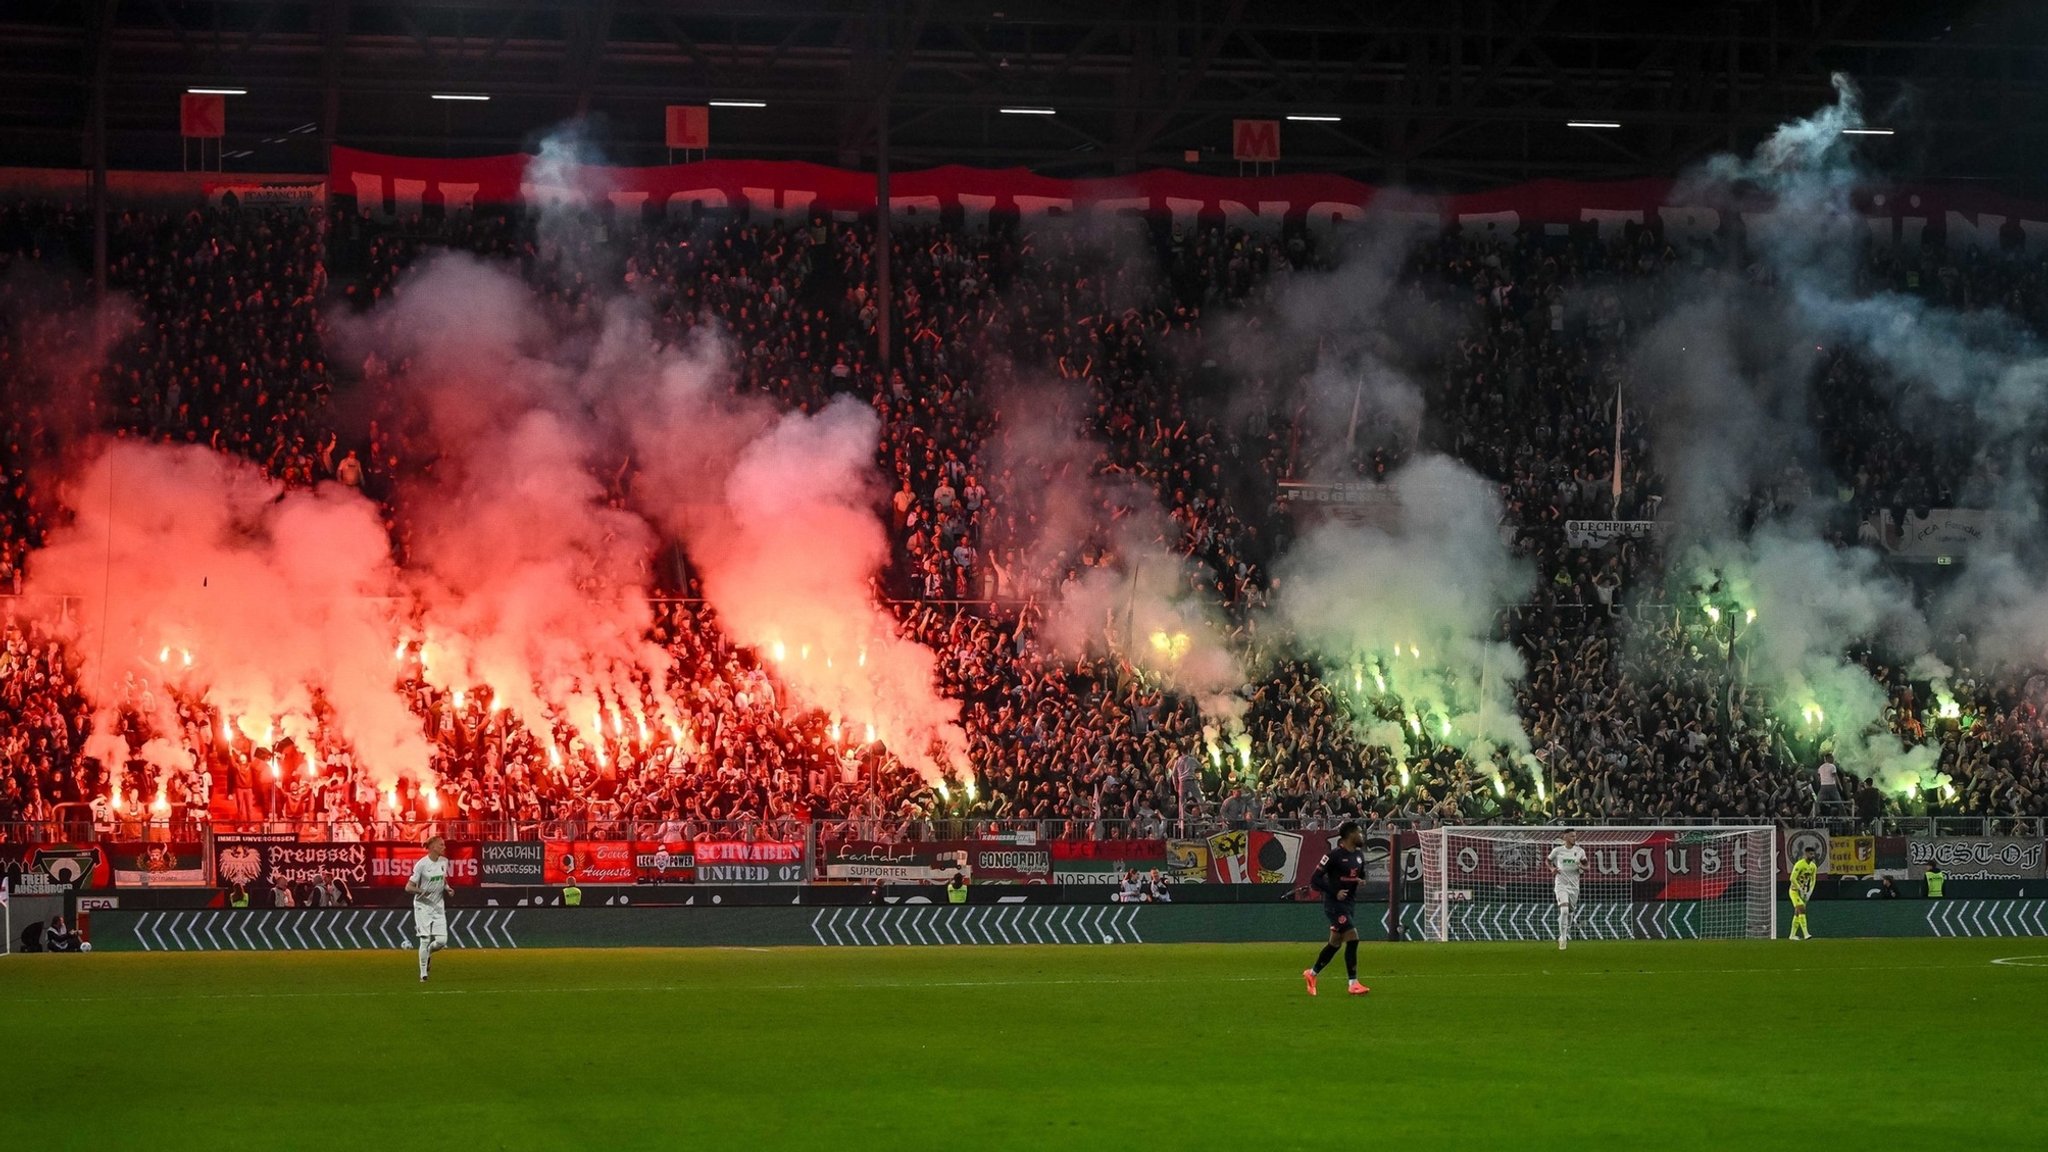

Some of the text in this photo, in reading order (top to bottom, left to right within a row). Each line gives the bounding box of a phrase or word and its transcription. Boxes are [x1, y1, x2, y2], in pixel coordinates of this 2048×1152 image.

[677, 109, 698, 144] L
[1236, 123, 1277, 157] M
[1580, 522, 1664, 532] LECHPIRATE
[596, 845, 629, 859] Bella
[697, 843, 801, 860] SCHWABEN
[836, 845, 916, 864] fanfahrt
[1069, 842, 1102, 857] FCA
[1125, 842, 1166, 857] FANS
[371, 858, 478, 877] DISSNTS
[638, 856, 693, 866] LECH POWER
[979, 851, 1049, 869] CONCORDIA
[482, 864, 541, 875] UNVERGESSEN
[579, 864, 632, 881] Augusta
[698, 865, 801, 880] UNITED 07
[850, 866, 907, 877] SUPPORTER
[21, 873, 50, 885] FREIE
[81, 900, 112, 910] FCA
